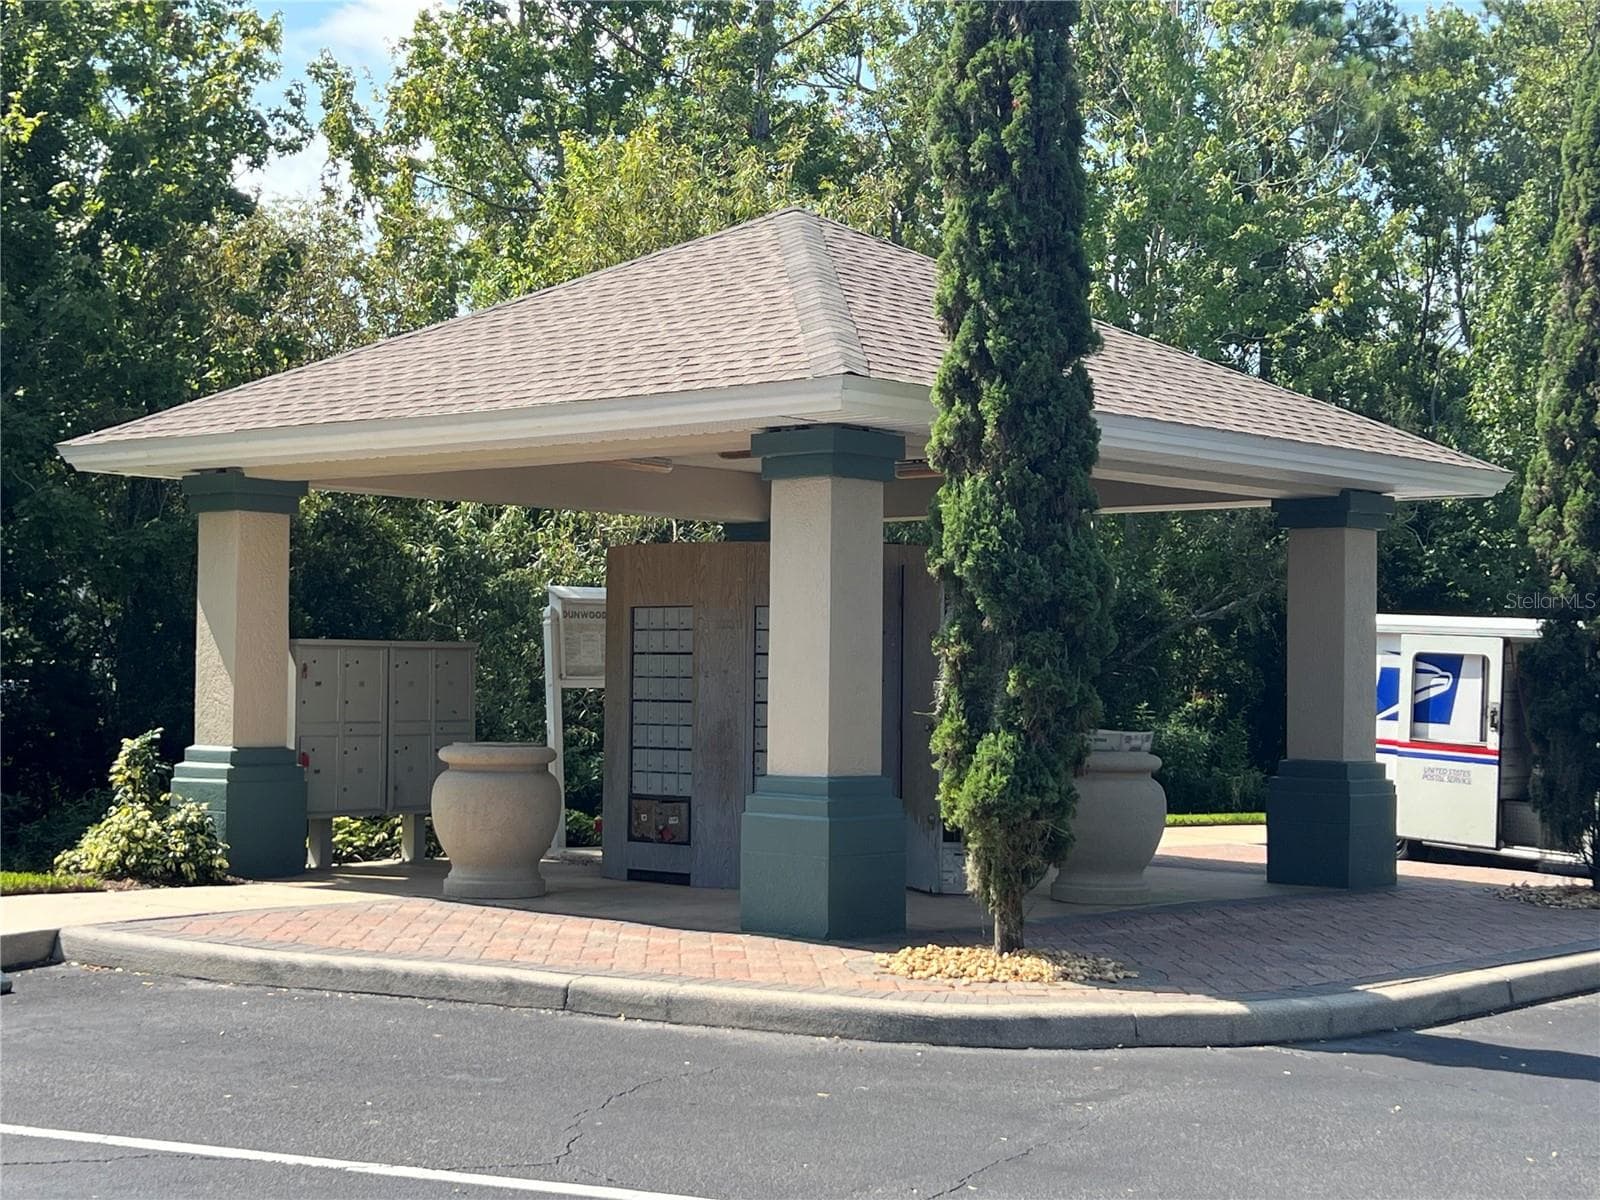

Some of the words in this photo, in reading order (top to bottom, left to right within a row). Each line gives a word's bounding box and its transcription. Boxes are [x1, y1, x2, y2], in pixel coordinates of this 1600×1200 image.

[1423, 766, 1448, 775] UNITED
[1448, 768, 1471, 777] STATES
[1422, 774, 1445, 782] POSTAL
[1446, 776, 1472, 785] SERVICE
